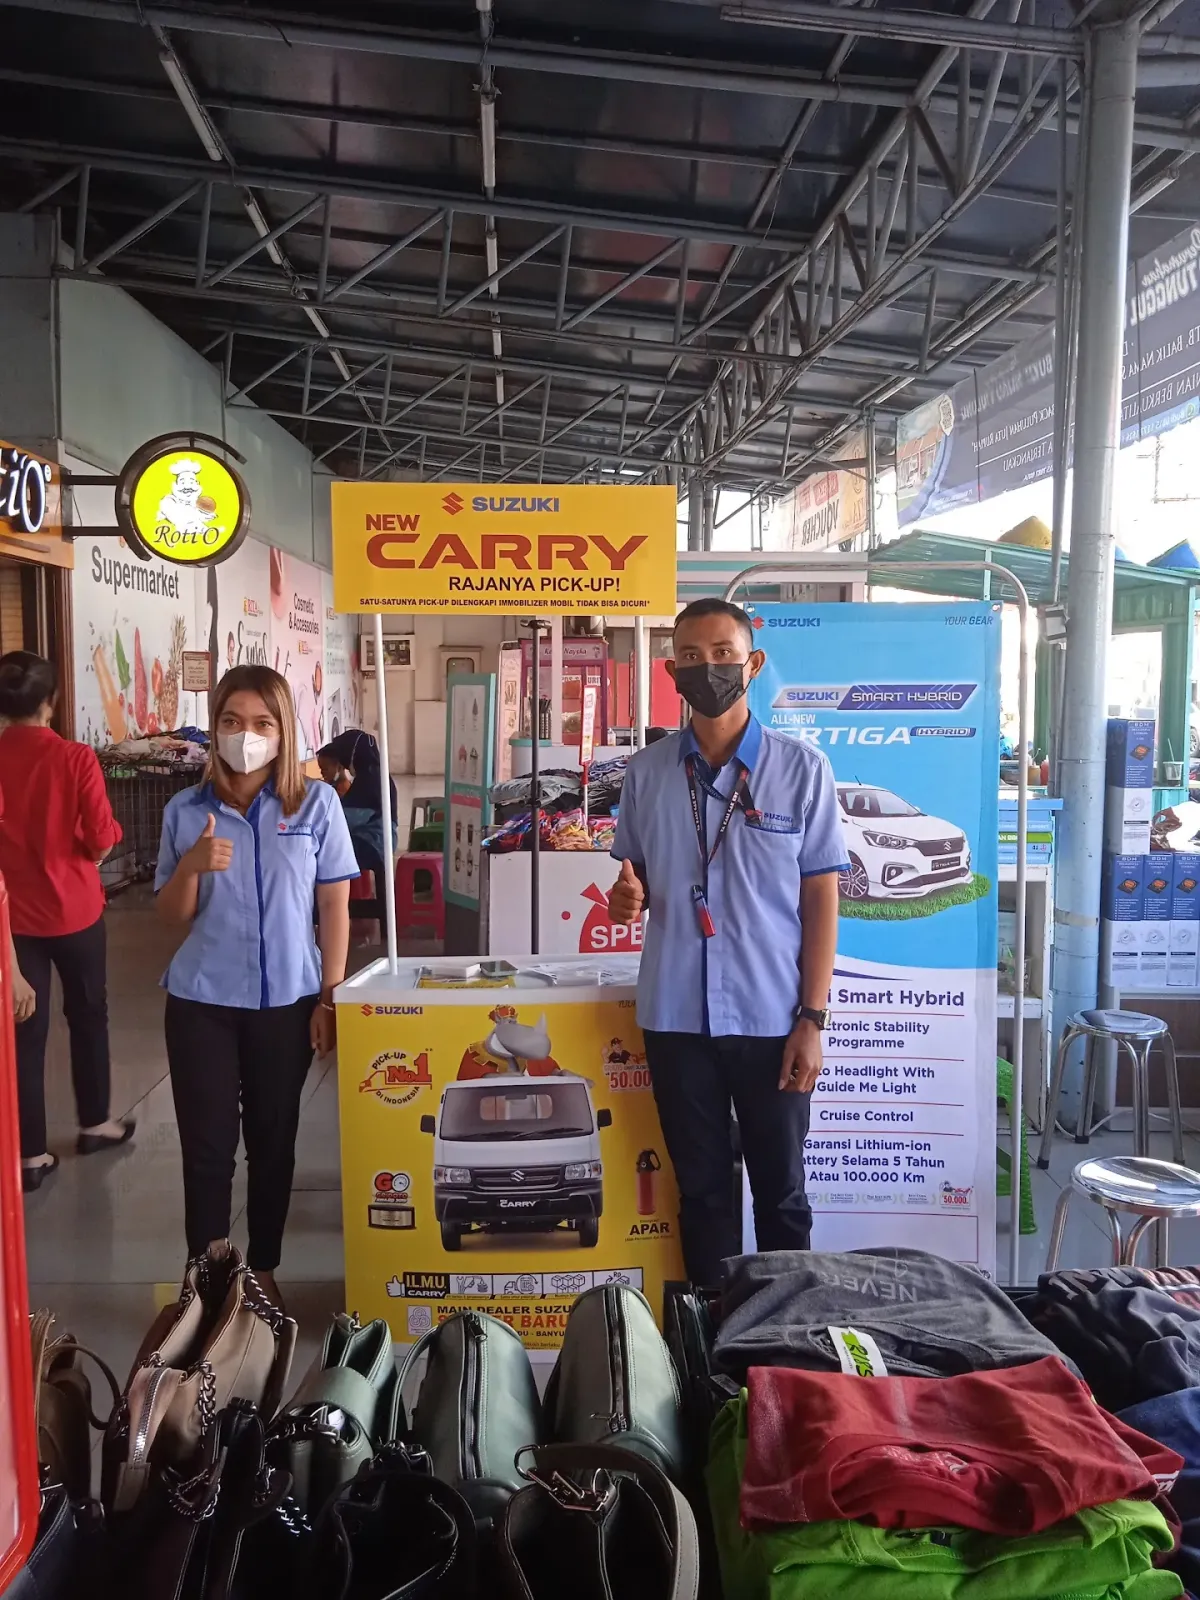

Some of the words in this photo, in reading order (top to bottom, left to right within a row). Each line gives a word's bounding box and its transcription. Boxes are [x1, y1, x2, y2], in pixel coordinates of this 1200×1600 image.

[472, 496, 560, 513] SUZUKI
[365, 513, 421, 531] NEW
[366, 533, 649, 571] CARRY
[91, 544, 180, 600] Supermarket
[448, 576, 536, 592] RAJANYA
[540, 577, 621, 592] PICK-UP!
[293, 592, 315, 615] Cosmetic
[359, 598, 417, 608] SATU-SATUNYA
[418, 598, 450, 608] PICK-UP
[451, 598, 497, 608] DILENGKAPI
[498, 598, 549, 608] IMMOBILIZER
[550, 598, 575, 608] MOBIL
[576, 598, 600, 608] TIDAK
[601, 598, 620, 608] BISA
[293, 612, 320, 635] Accessories
[768, 617, 821, 628] SUZUKI
[944, 615, 967, 626] YOUR
[968, 616, 993, 626] GEAR
[786, 690, 840, 701] SUZUKI
[851, 691, 904, 703] SMART
[907, 691, 963, 703] HYBRID
[771, 713, 816, 725] ALL-NEW
[917, 728, 969, 737] HYBRID
[837, 988, 893, 1004] Smart
[899, 989, 965, 1007] Hybrid
[375, 1005, 423, 1016] SUZUKI
[874, 1020, 930, 1035] Stability
[828, 1036, 905, 1050] Programme
[371, 1051, 407, 1070] PICK-UP
[834, 1065, 899, 1081] Headlight
[903, 1066, 935, 1079] With
[817, 1081, 856, 1094] Guide
[859, 1081, 878, 1093] Me
[882, 1081, 917, 1096] Light
[375, 1089, 384, 1099] DI
[383, 1086, 420, 1105] INDONESIA
[819, 1110, 861, 1122] Cruise
[864, 1110, 914, 1122] Control
[803, 1139, 852, 1151] Garansi
[855, 1139, 931, 1152] Lithium-ion
[841, 1155, 889, 1167] Selama
[893, 1156, 901, 1167] 5
[905, 1156, 945, 1168] Tahun
[809, 1171, 839, 1183] Atau
[843, 1171, 899, 1183] 100.000
[903, 1172, 925, 1184] Km
[500, 1200, 537, 1209] CARRY
[629, 1222, 670, 1235] APAR
[822, 1271, 918, 1303] NEVER
[437, 1306, 472, 1314] MAIN
[477, 1305, 533, 1315] DEALER
